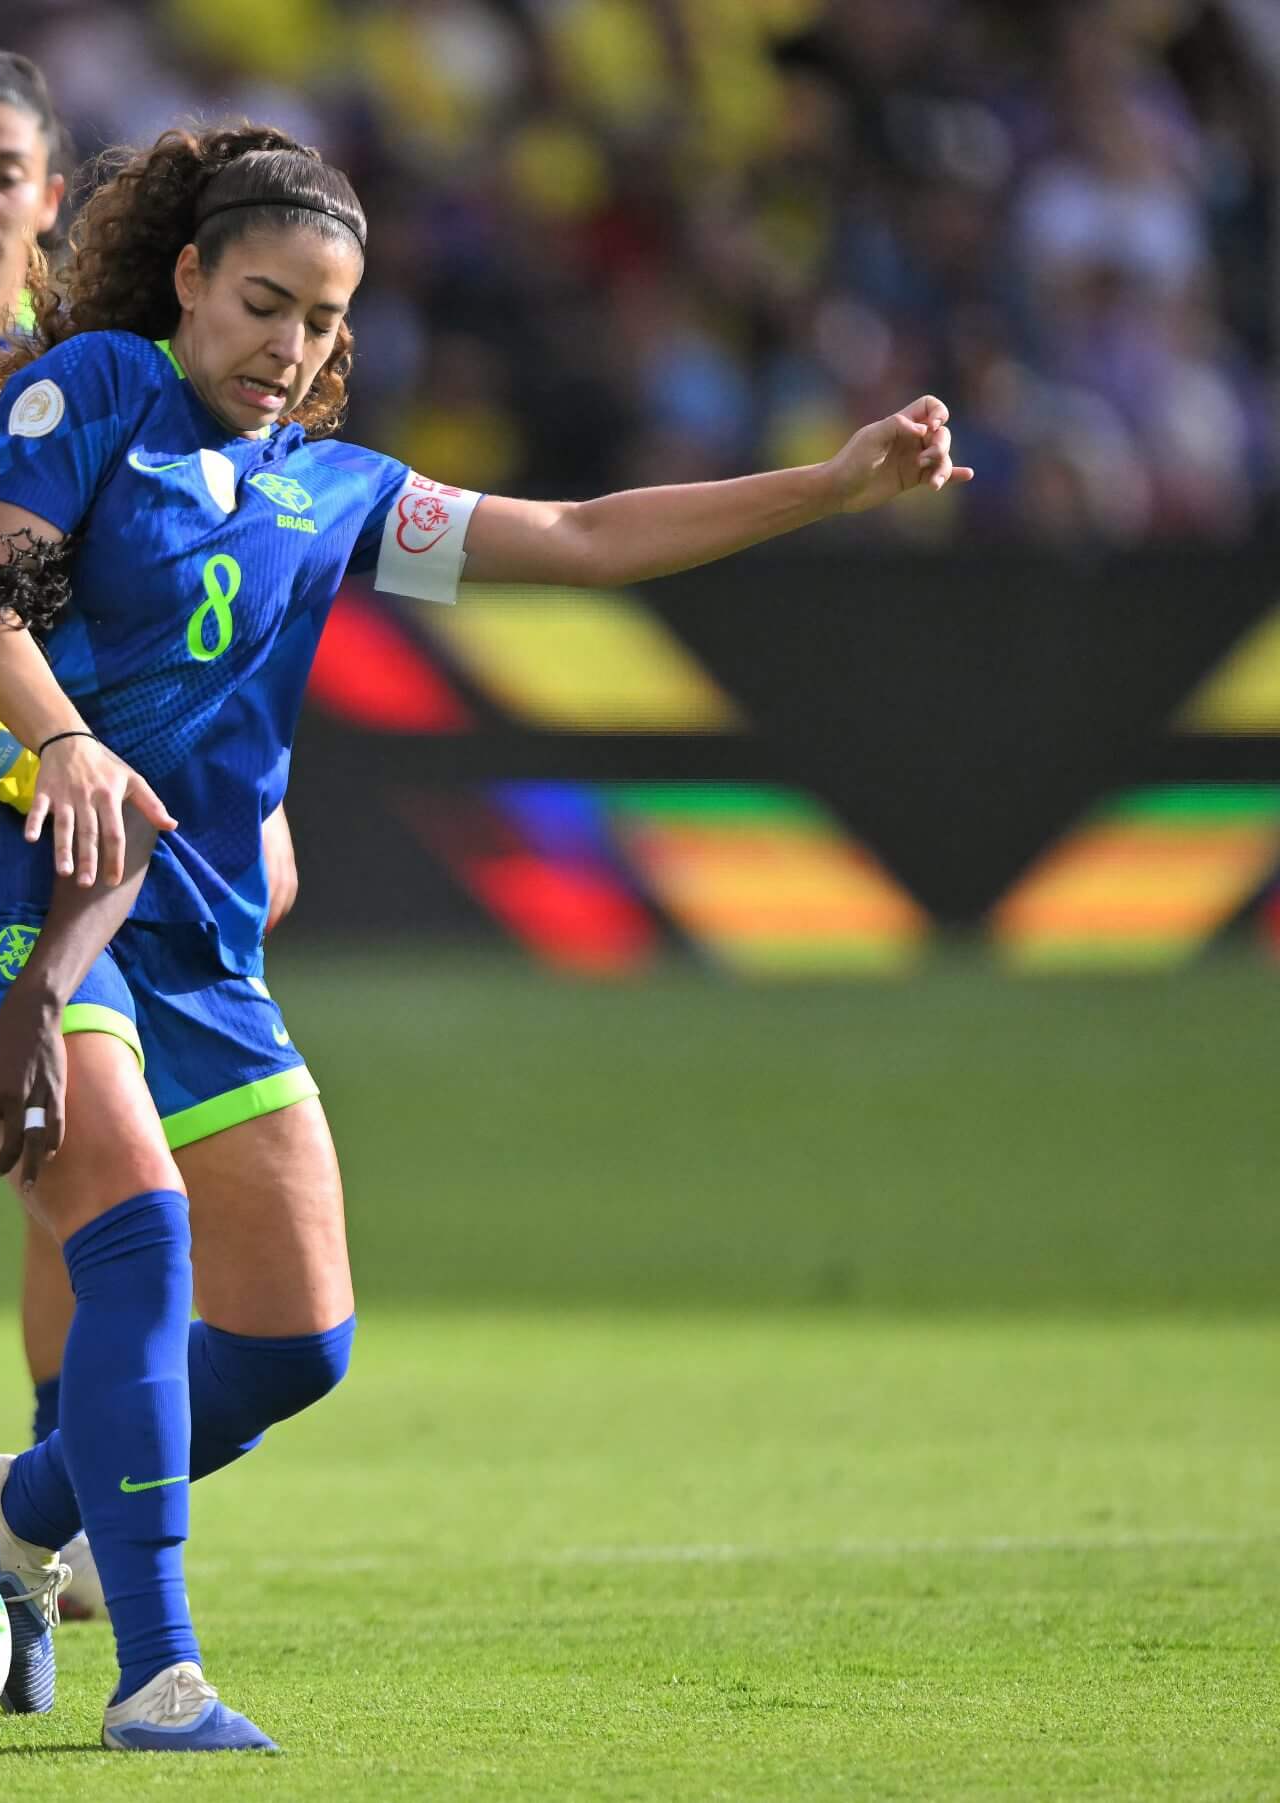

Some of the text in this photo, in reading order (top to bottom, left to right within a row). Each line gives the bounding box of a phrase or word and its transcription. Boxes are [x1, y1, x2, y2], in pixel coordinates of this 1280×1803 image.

[277, 513, 318, 534] BRASIL
[187, 553, 241, 661] 8
[11, 945, 31, 958] CBF
